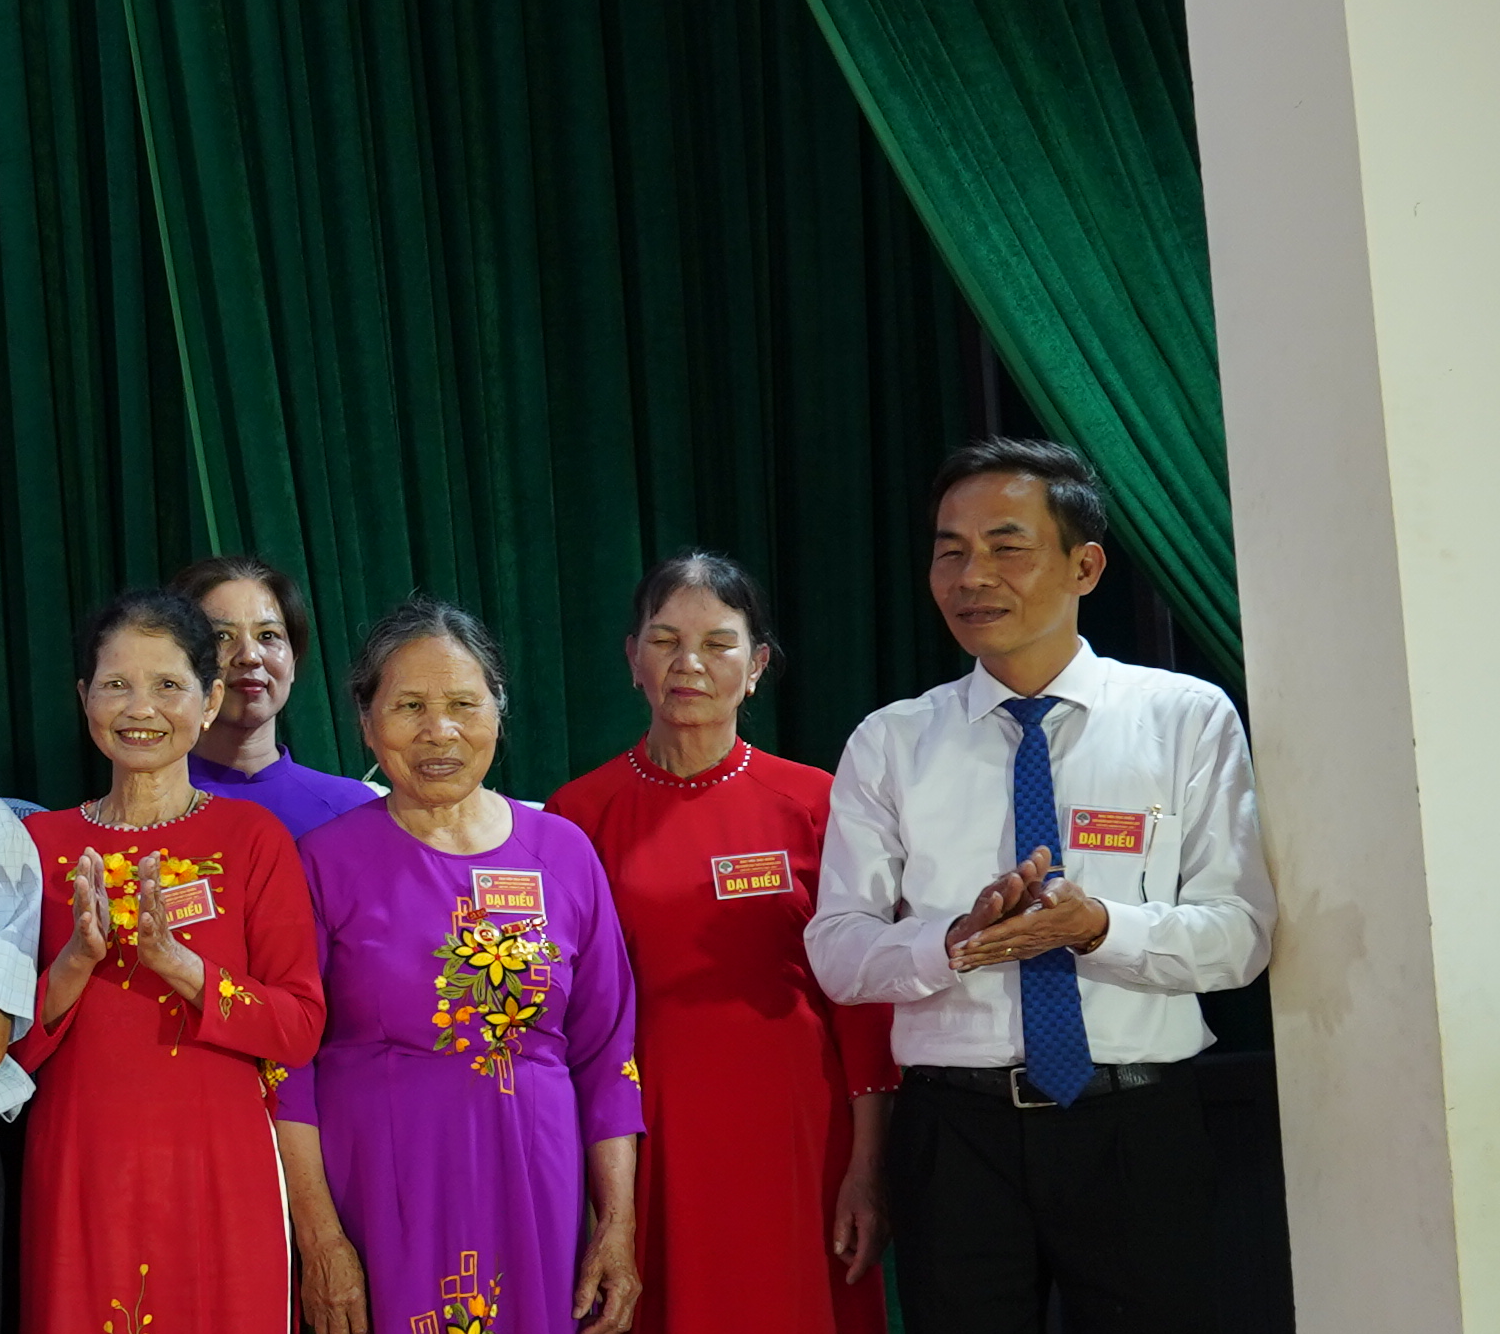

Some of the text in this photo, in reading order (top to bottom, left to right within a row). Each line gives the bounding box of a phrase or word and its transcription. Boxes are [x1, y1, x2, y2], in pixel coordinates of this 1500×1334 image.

[1104, 830, 1136, 848] BIỂU
[750, 870, 782, 889] BIỂU
[507, 890, 535, 907] BIỂU
